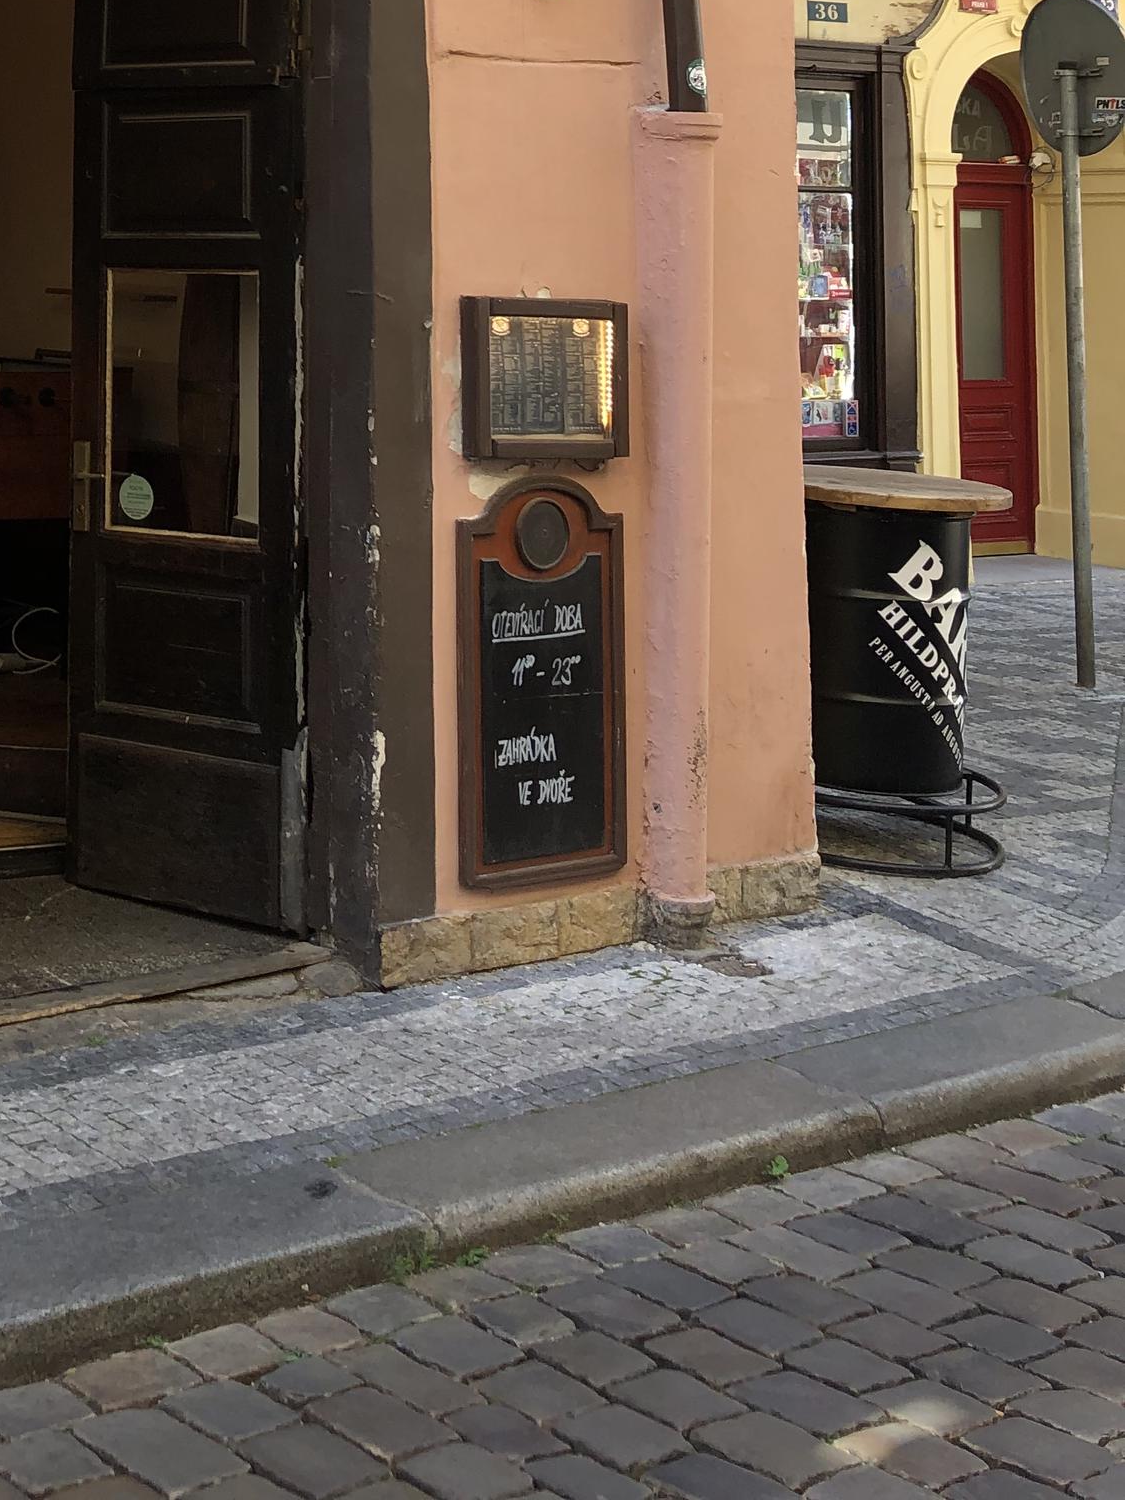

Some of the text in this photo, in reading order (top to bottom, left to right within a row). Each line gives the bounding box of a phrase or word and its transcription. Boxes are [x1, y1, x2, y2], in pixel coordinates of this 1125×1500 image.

[815, 3, 839, 20] 36
[554, 603, 583, 632] DOBA
[868, 636, 894, 663] PER
[931, 710, 944, 726] AD
[497, 726, 557, 767] ZAHRÁDKA
[518, 781, 533, 805] VE
